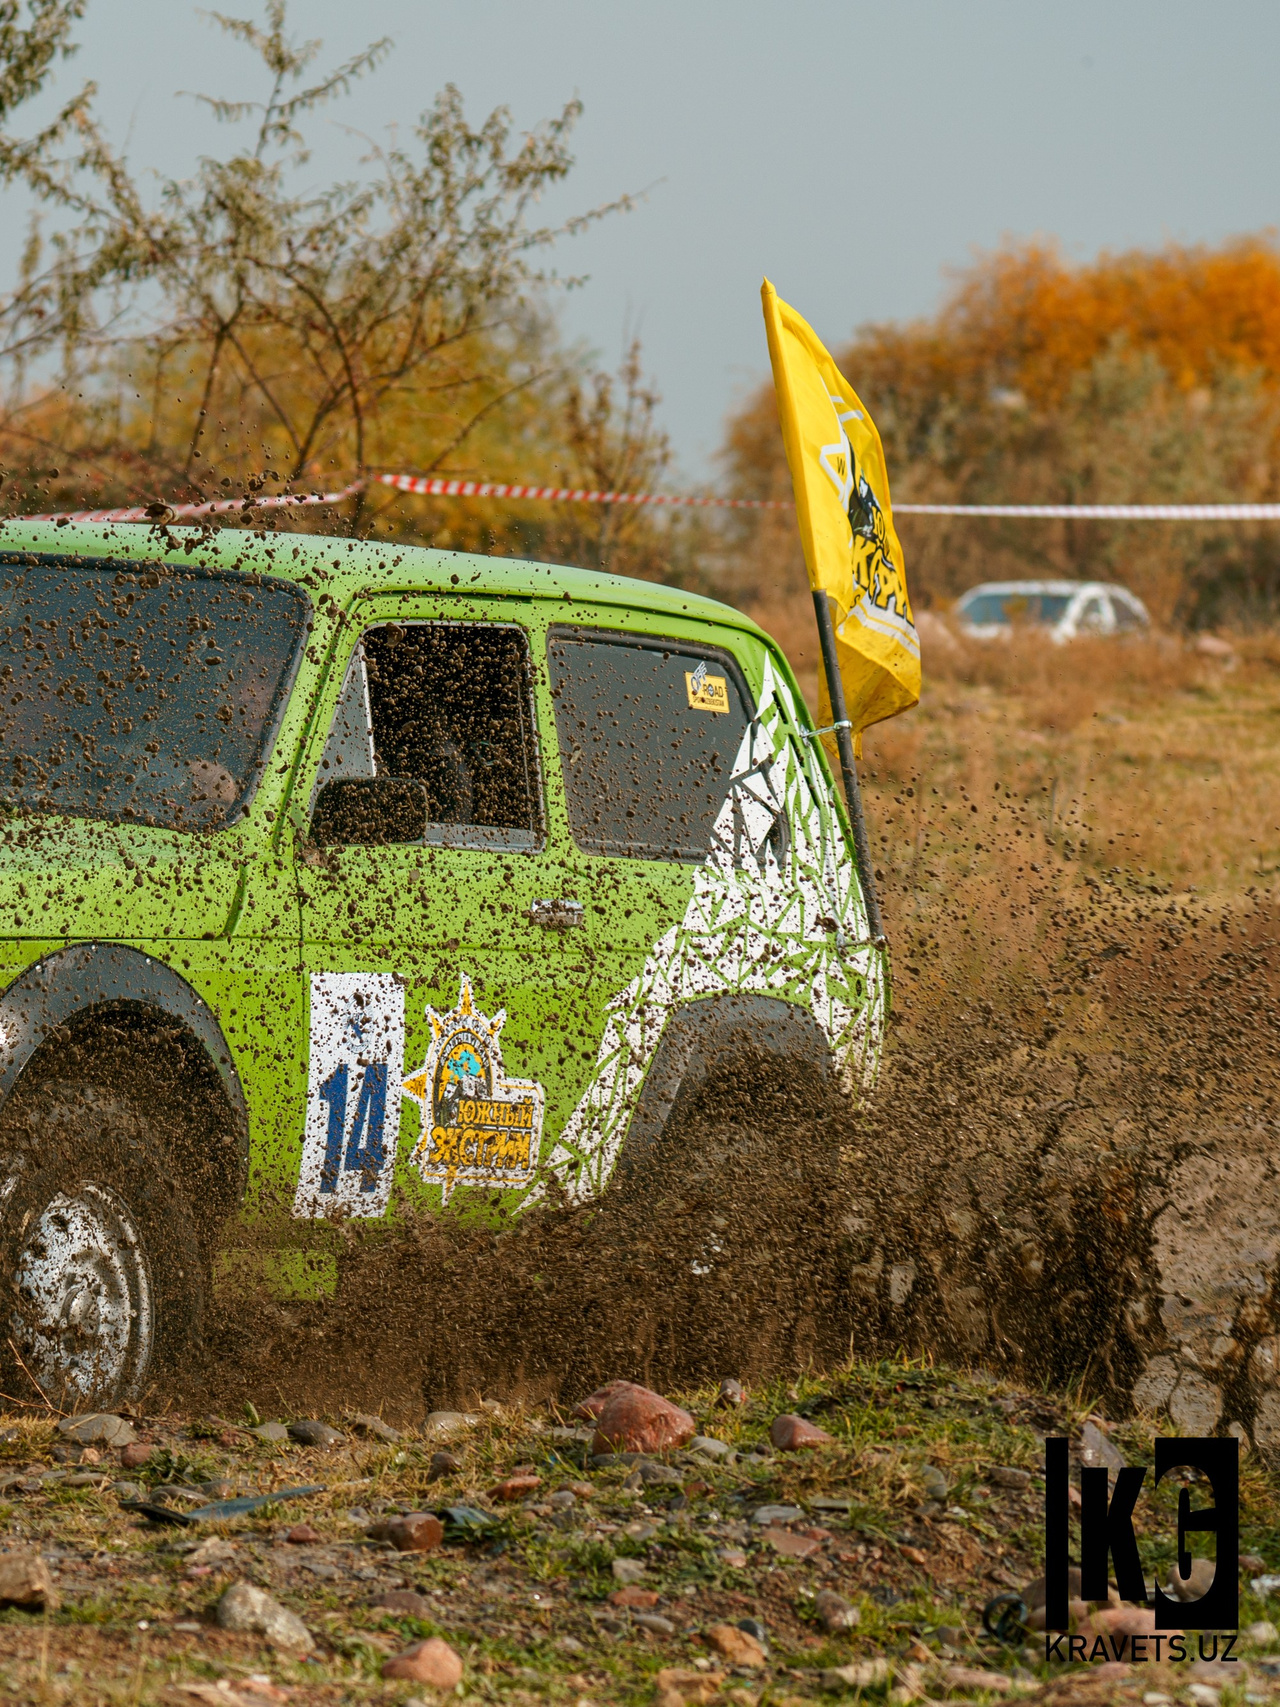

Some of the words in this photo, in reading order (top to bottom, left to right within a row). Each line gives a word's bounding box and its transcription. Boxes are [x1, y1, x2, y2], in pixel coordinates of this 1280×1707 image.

[690, 661, 708, 693] OFF
[702, 684, 724, 698] ROAD
[457, 1096, 533, 1128] ЮЖНЫЙ
[319, 1064, 388, 1193] 14
[429, 1125, 531, 1170] ЭКСТРИМ
